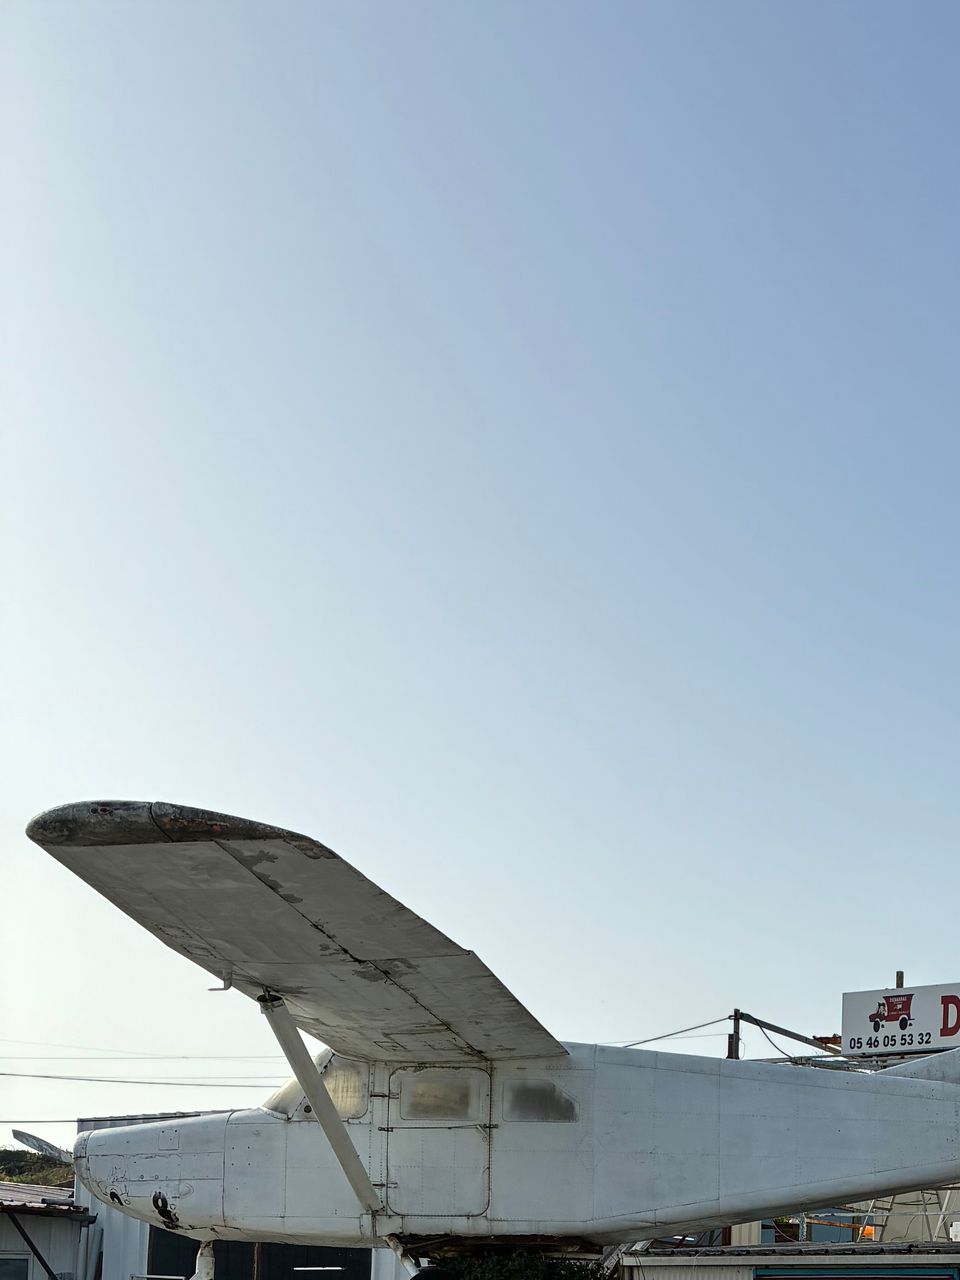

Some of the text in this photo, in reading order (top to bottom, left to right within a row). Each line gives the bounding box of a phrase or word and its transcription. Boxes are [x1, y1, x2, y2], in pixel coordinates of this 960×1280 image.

[849, 1032, 932, 1050] 05 46 05 53 32
